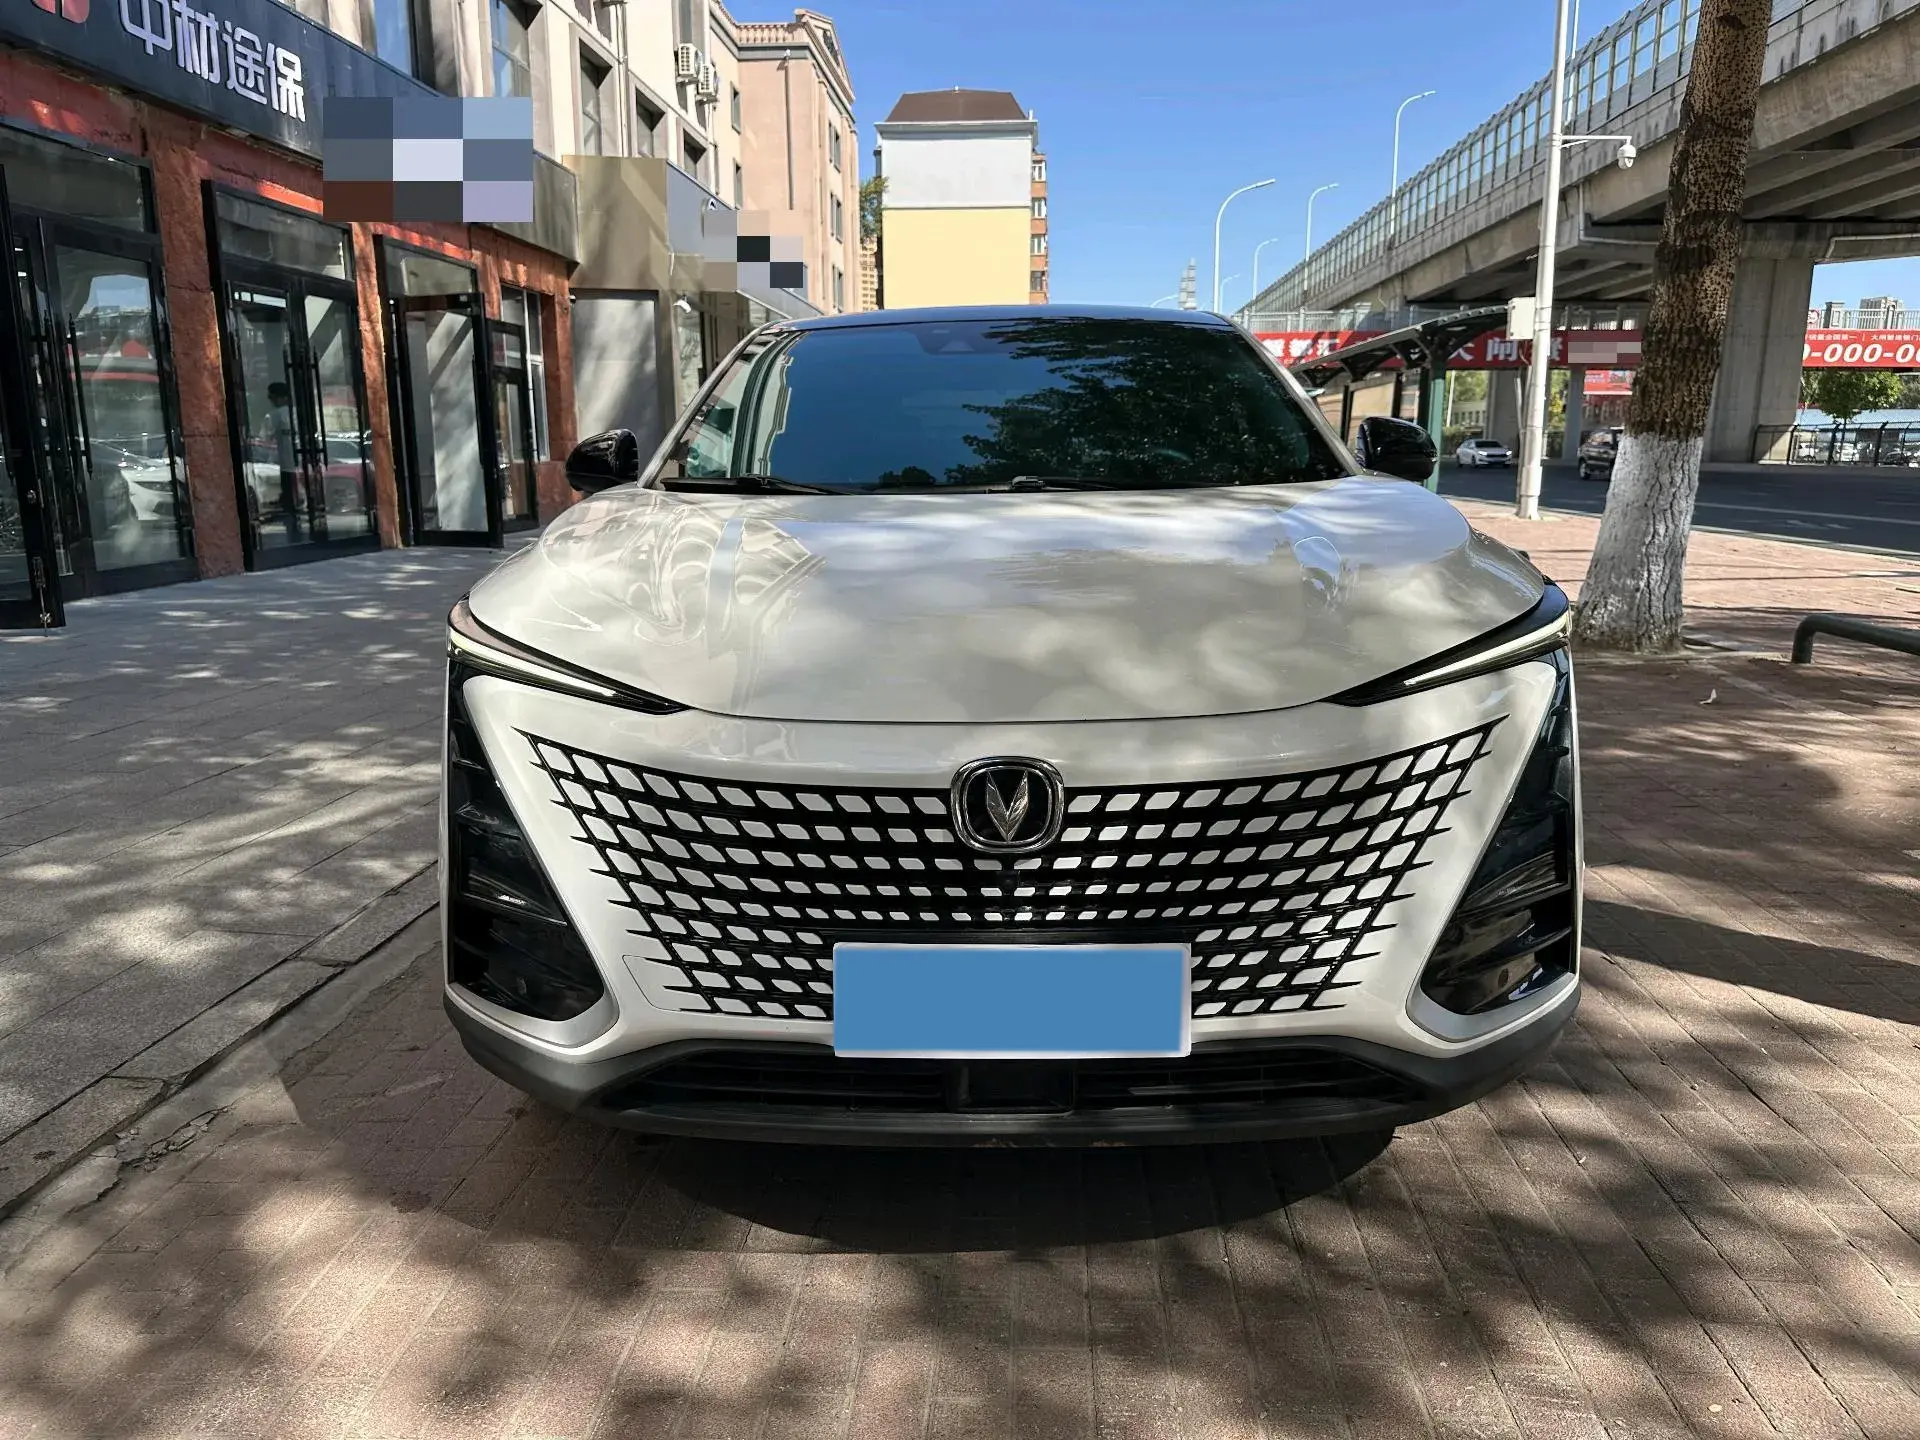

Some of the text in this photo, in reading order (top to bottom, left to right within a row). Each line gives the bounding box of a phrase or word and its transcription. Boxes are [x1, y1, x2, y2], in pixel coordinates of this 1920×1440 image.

[118, 0, 306, 122] 中材途保
[1803, 343, 1920, 363] -000-0
